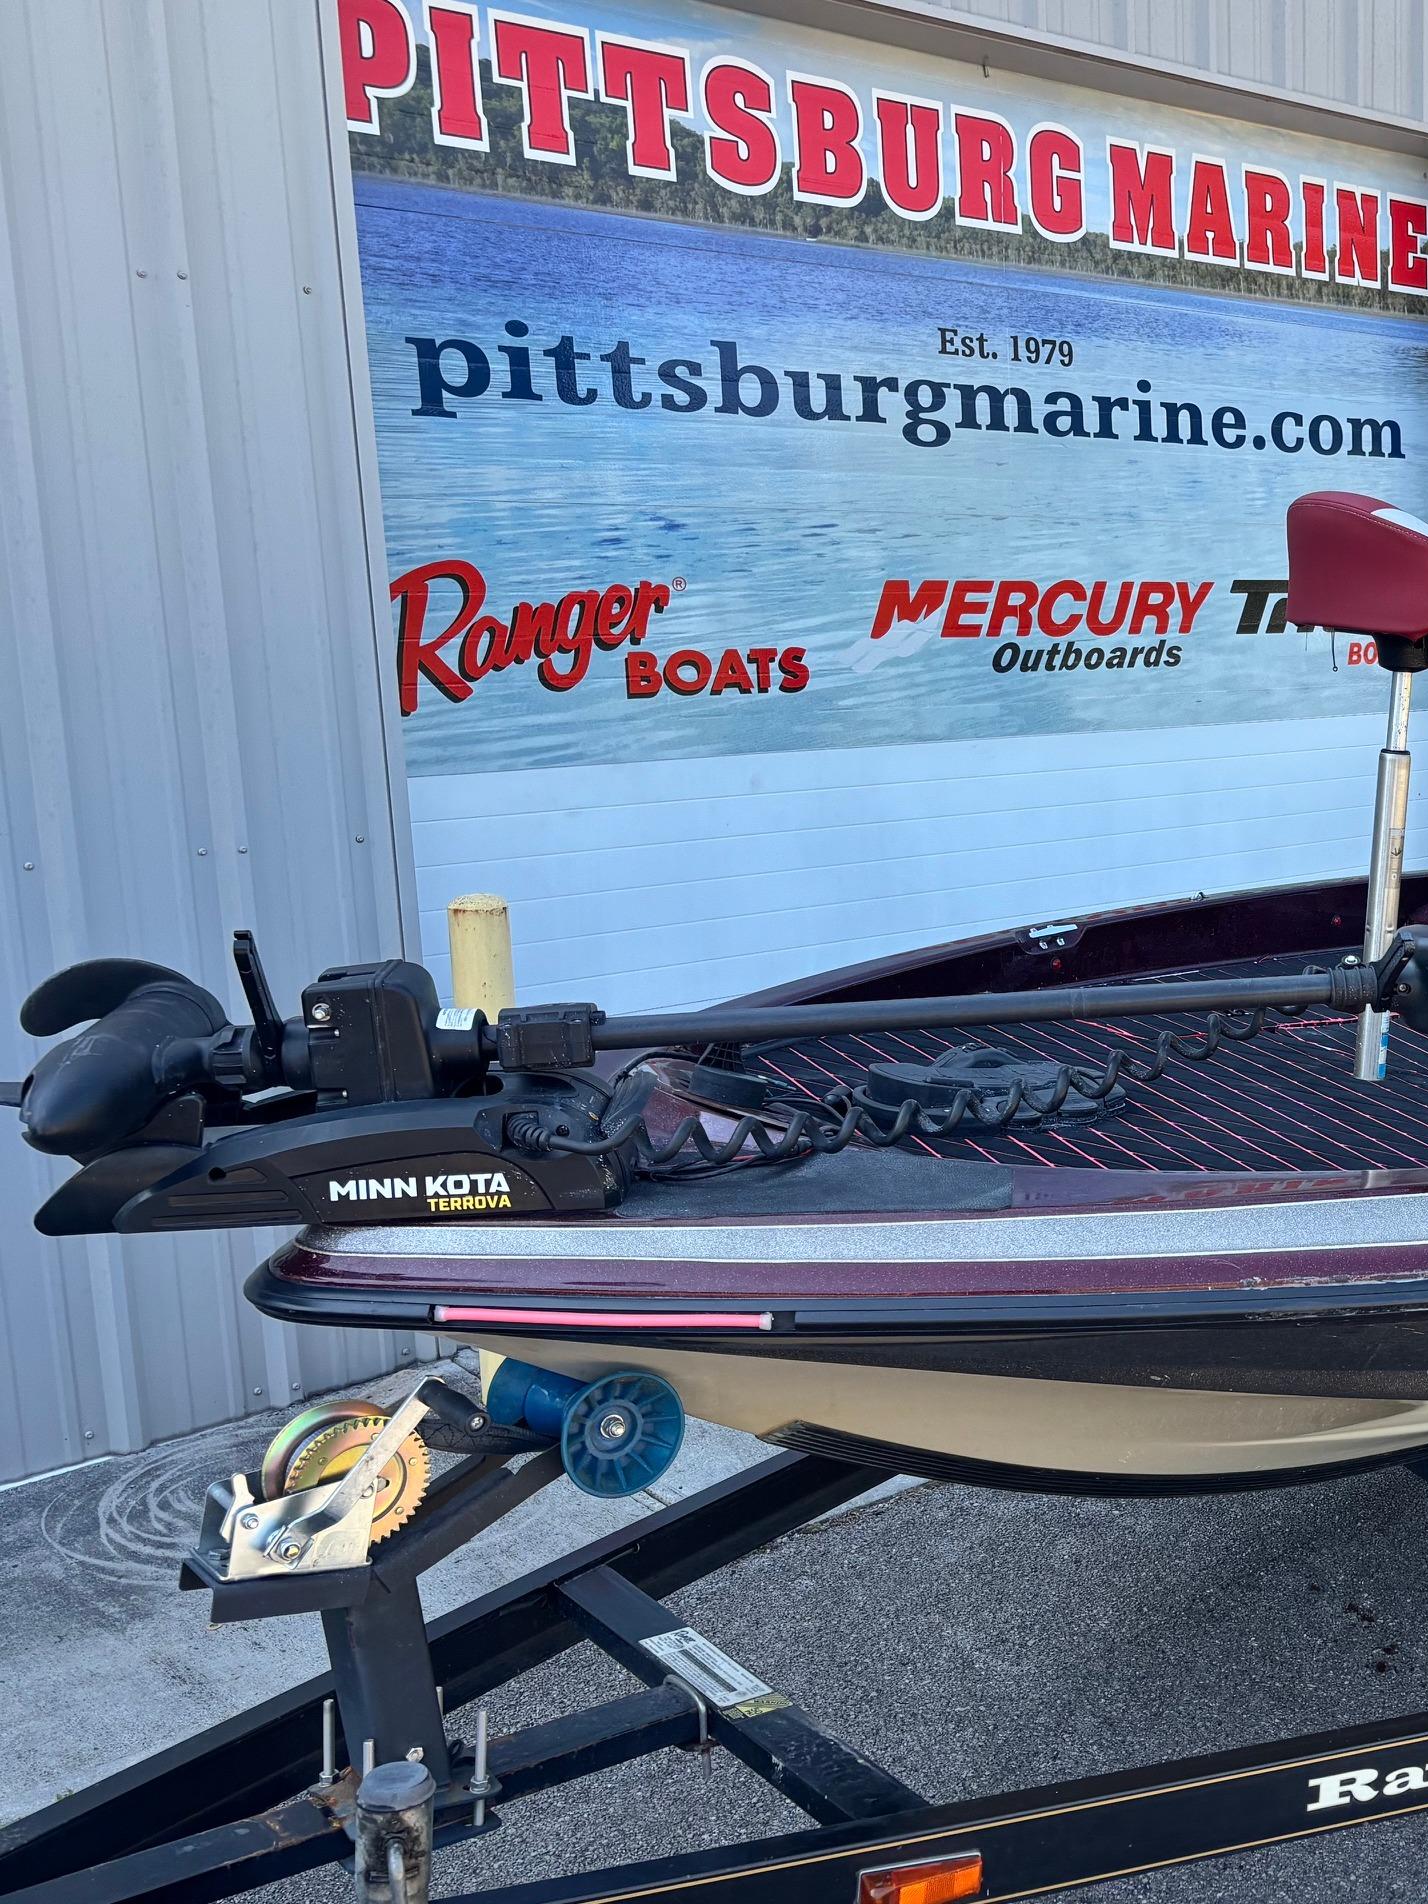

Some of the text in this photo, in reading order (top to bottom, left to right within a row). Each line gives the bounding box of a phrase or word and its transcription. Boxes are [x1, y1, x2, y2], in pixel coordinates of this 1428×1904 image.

[338, 0, 1087, 242] PITTSBURG
[938, 327, 1074, 367] Est. 1979
[405, 320, 1405, 459] pittsburgmarine.com
[869, 579, 1215, 640] MERCURY
[625, 647, 811, 699] BOATS
[991, 639, 1184, 674] Outboards
[329, 1172, 511, 1202] MINN KOTA
[427, 1194, 512, 1212] TERROVA
